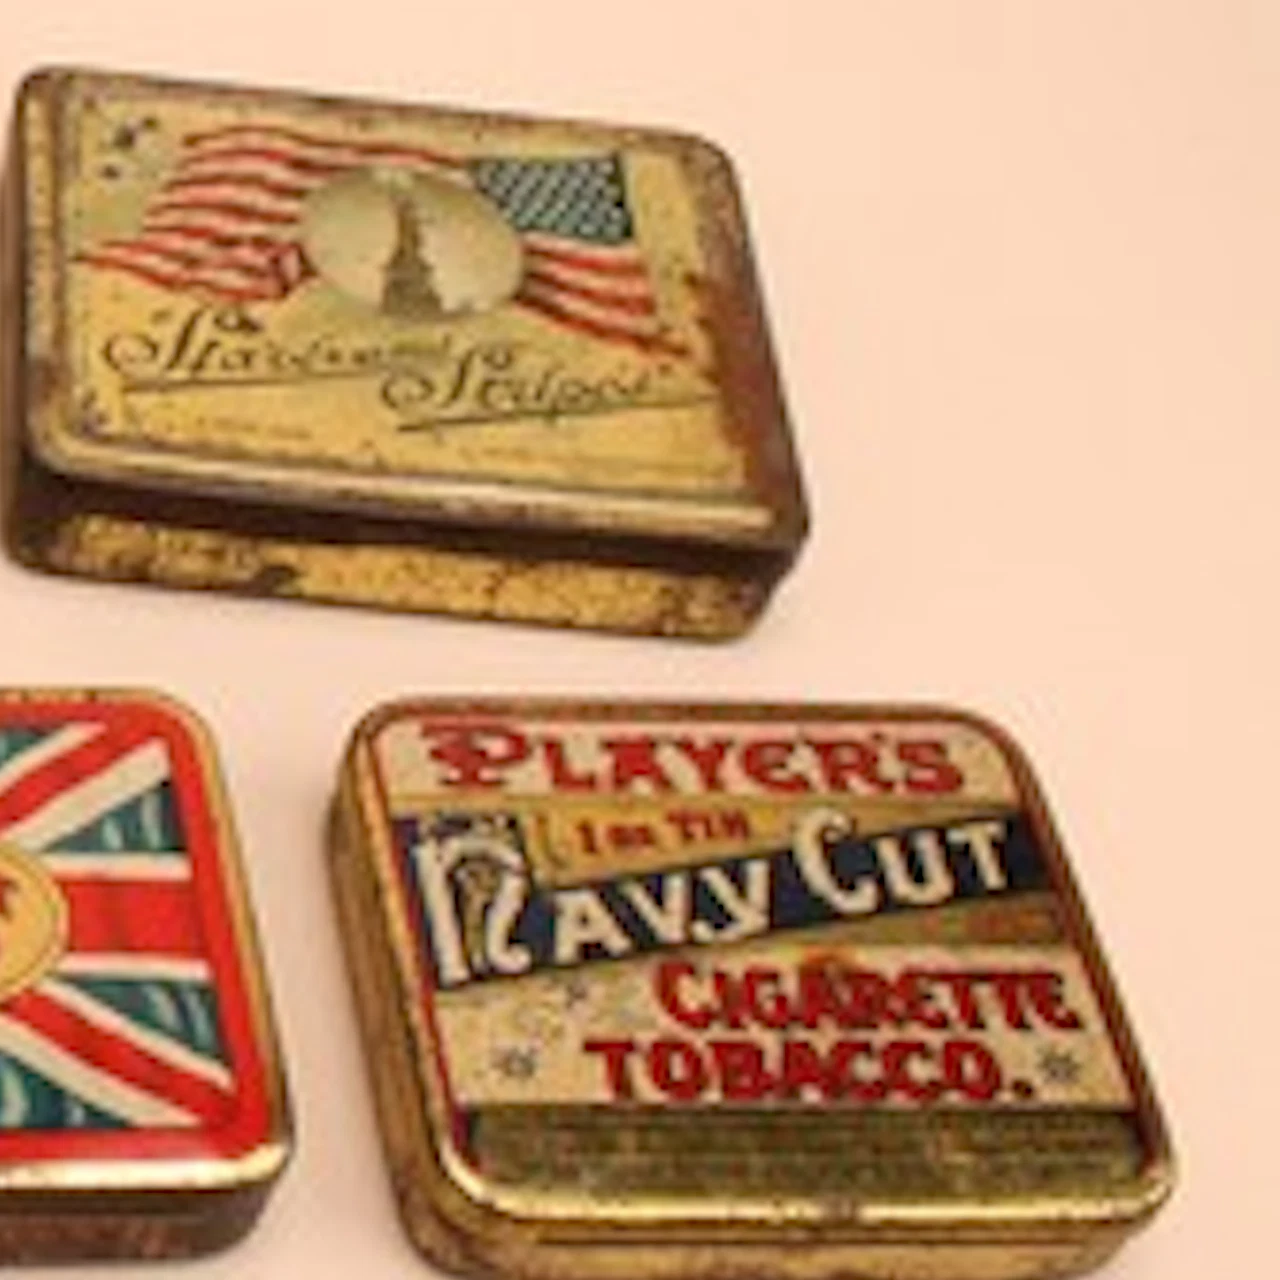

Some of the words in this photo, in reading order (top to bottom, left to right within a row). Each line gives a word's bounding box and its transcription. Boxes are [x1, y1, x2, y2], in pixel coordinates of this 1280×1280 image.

[416, 826, 771, 990] NAVY
[792, 806, 1013, 915] CUT
[651, 953, 1087, 1032] CIGARETTE
